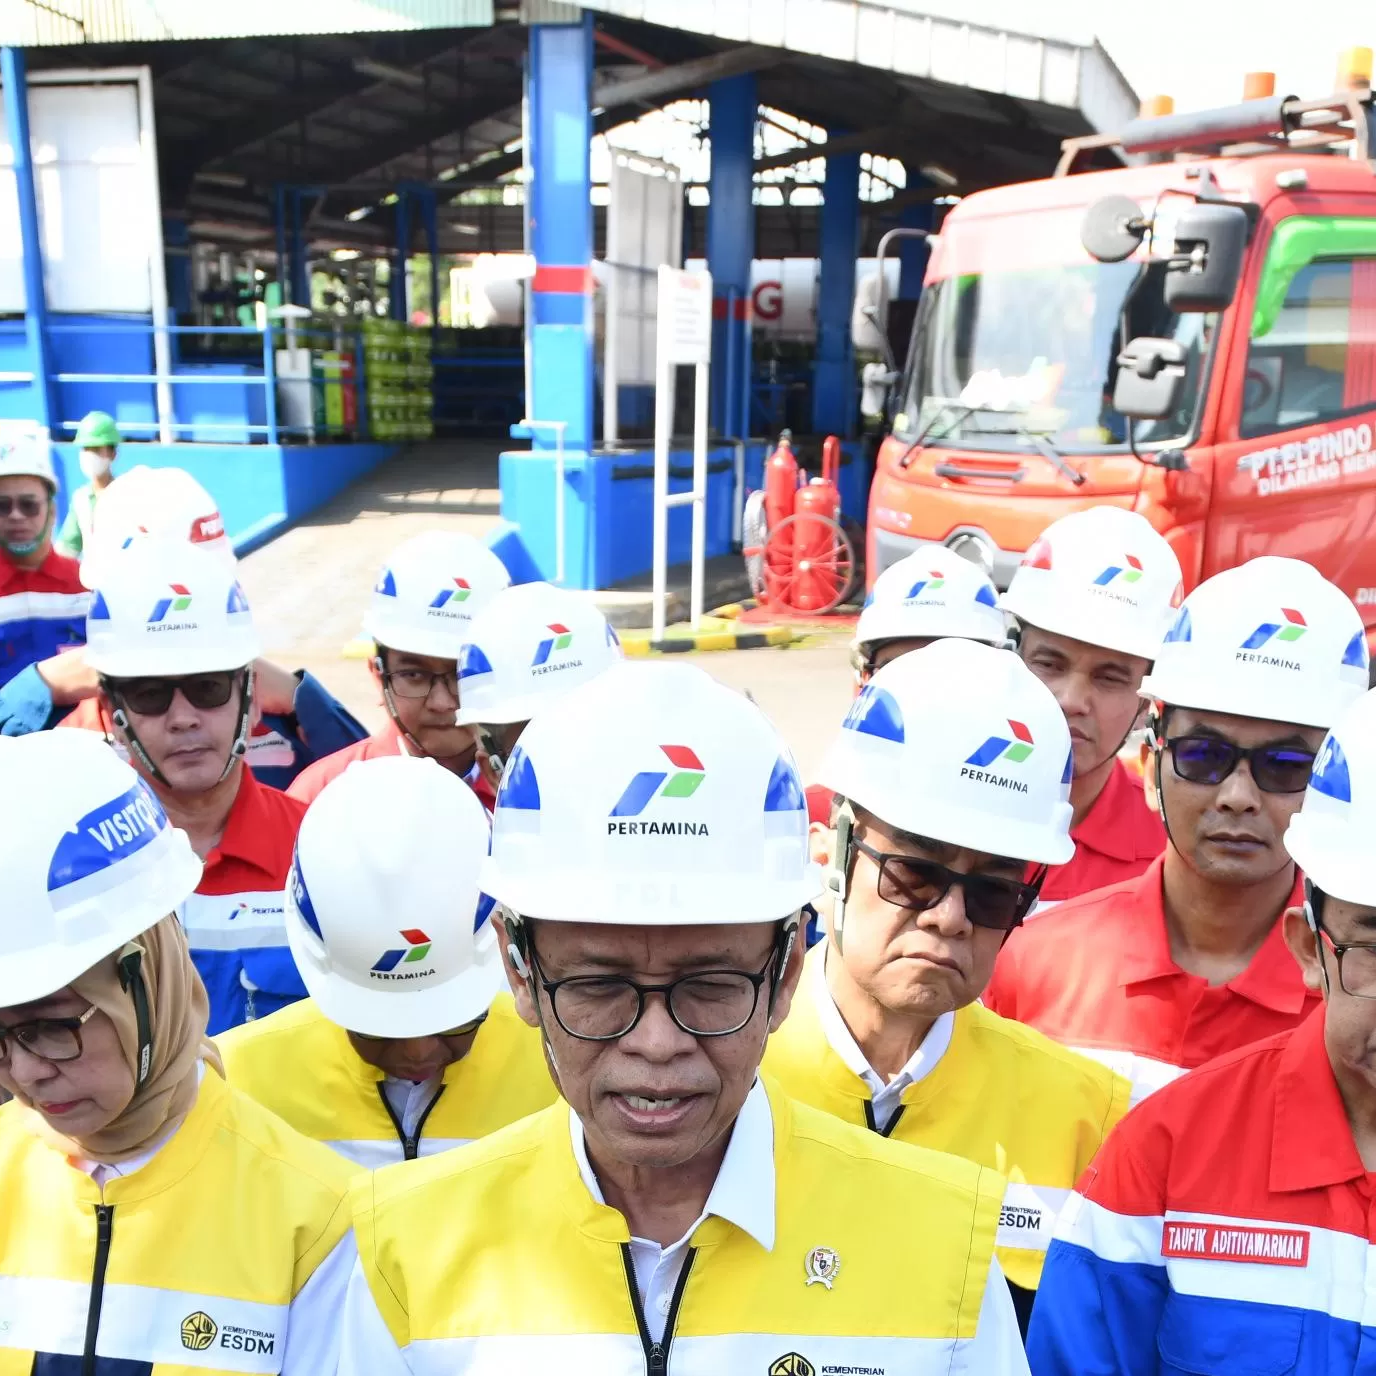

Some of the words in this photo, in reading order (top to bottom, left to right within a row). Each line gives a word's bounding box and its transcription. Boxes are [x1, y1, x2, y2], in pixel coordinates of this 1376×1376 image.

[1258, 461, 1338, 496] DILARANG
[902, 599, 946, 607] PERTAMINA
[1088, 588, 1138, 607] PERTAMINA
[427, 610, 472, 620] PERTAMINA
[146, 623, 197, 632] PERTAMINA
[532, 661, 582, 677] PERTAMINA
[1236, 652, 1301, 671] PERTAMINA
[961, 768, 1027, 795] PERTAMINA
[608, 822, 709, 837] PERTAMINA
[370, 970, 435, 980] PERTAMINA
[1001, 1205, 1041, 1215] EMENTERIAN
[998, 1212, 1041, 1230] ESDM
[1168, 1227, 1206, 1252] TAUFIK
[1211, 1230, 1303, 1259] ADITIYAWARMAN
[222, 1325, 274, 1339] KEMENTERIAN
[221, 1333, 274, 1355] ESDM
[821, 1366, 885, 1376] KEMENTERIAN
